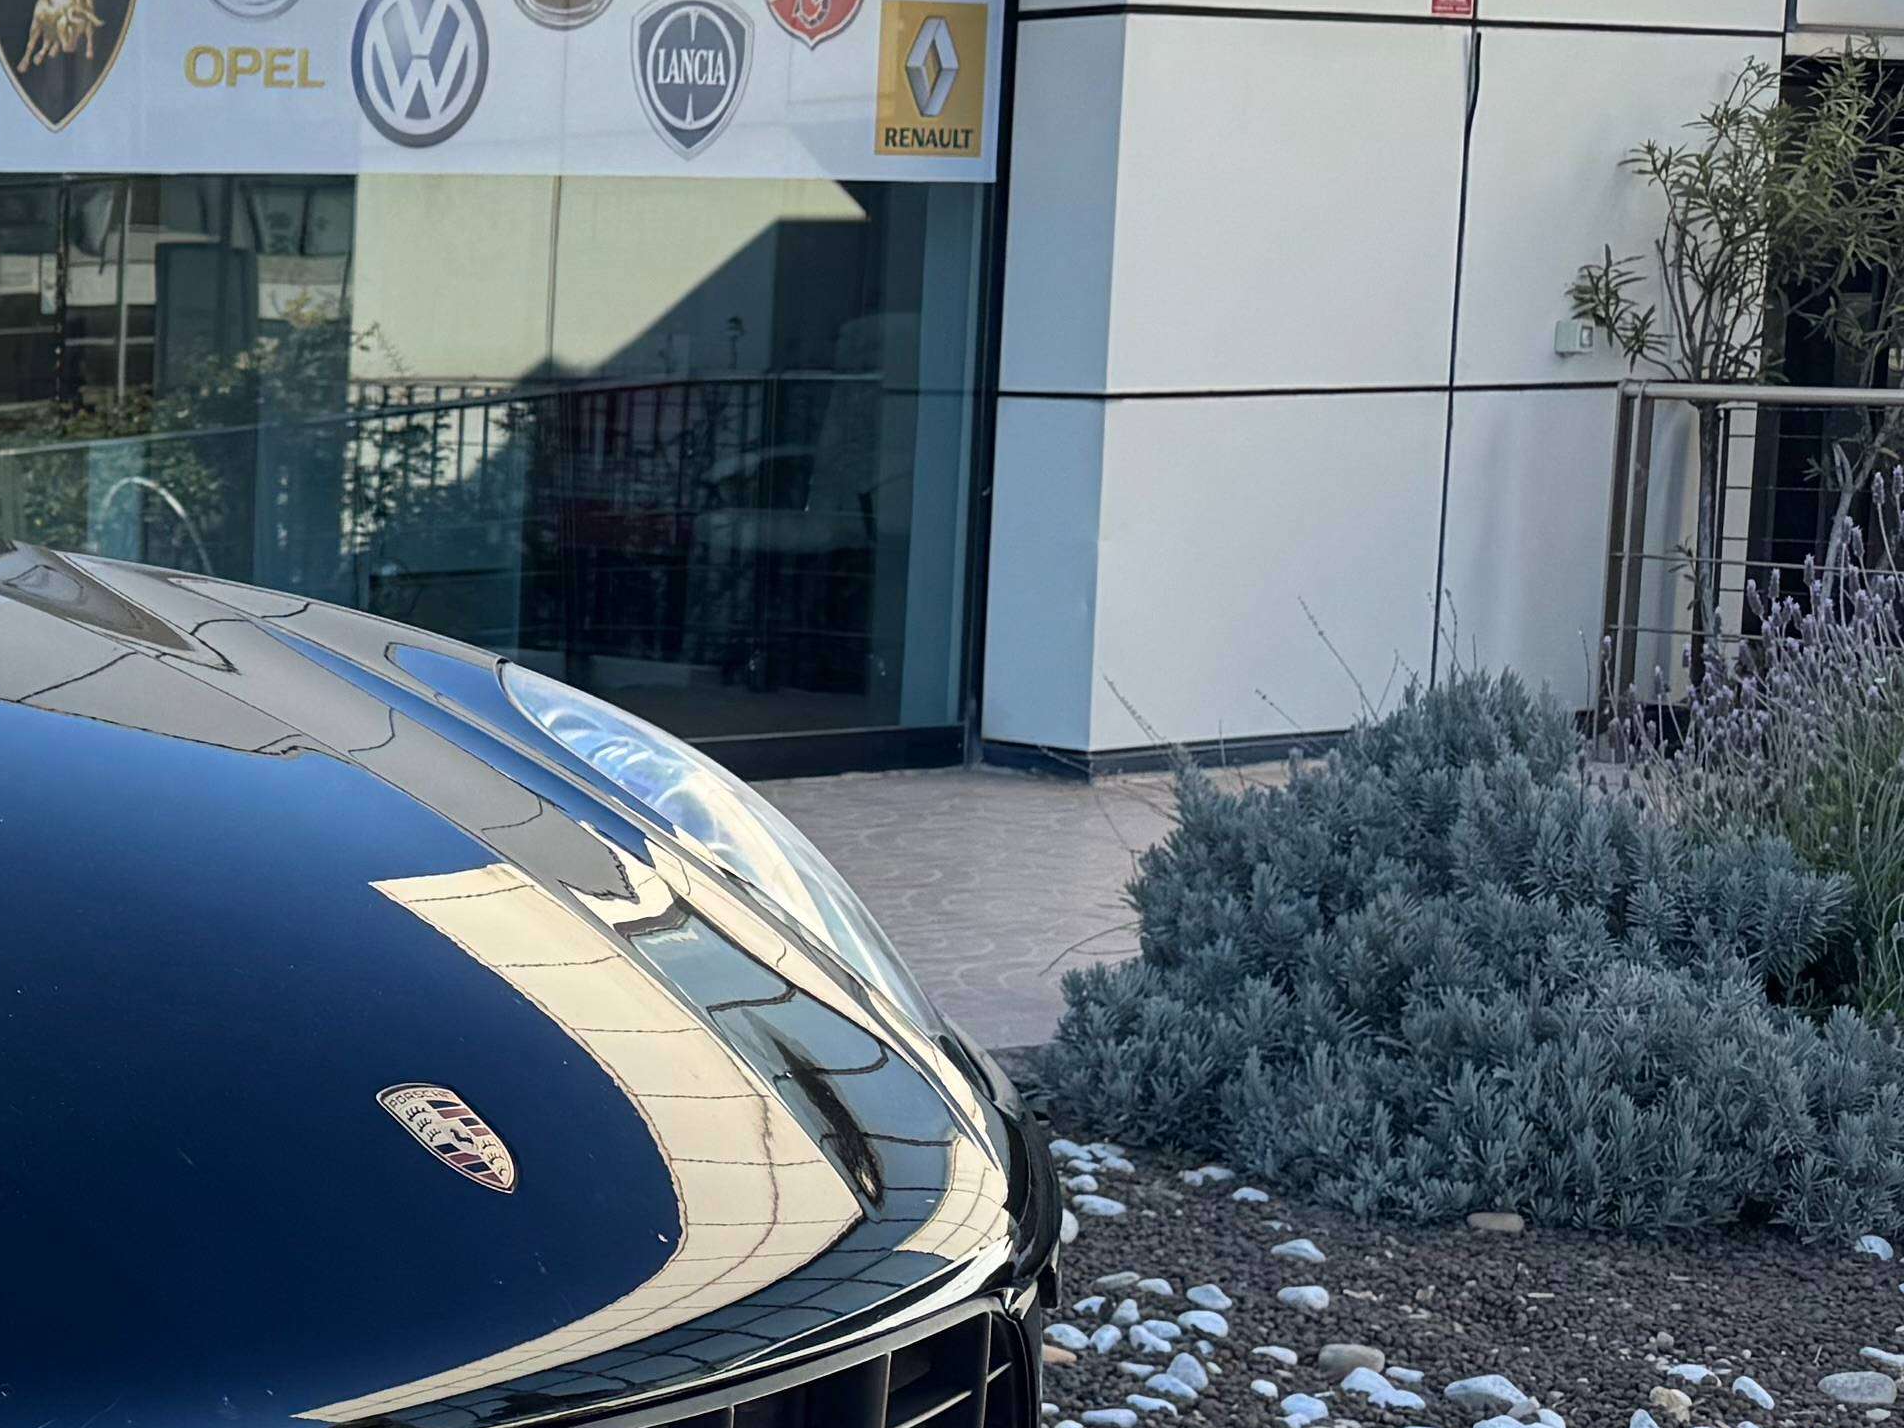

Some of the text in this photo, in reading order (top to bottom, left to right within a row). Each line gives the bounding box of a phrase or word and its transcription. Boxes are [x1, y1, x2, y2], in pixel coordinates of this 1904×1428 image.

[183, 44, 326, 91] OPEL
[656, 48, 727, 88] LANCIA
[883, 126, 974, 150] RENAULT
[388, 1089, 454, 1110] PORSCHE
